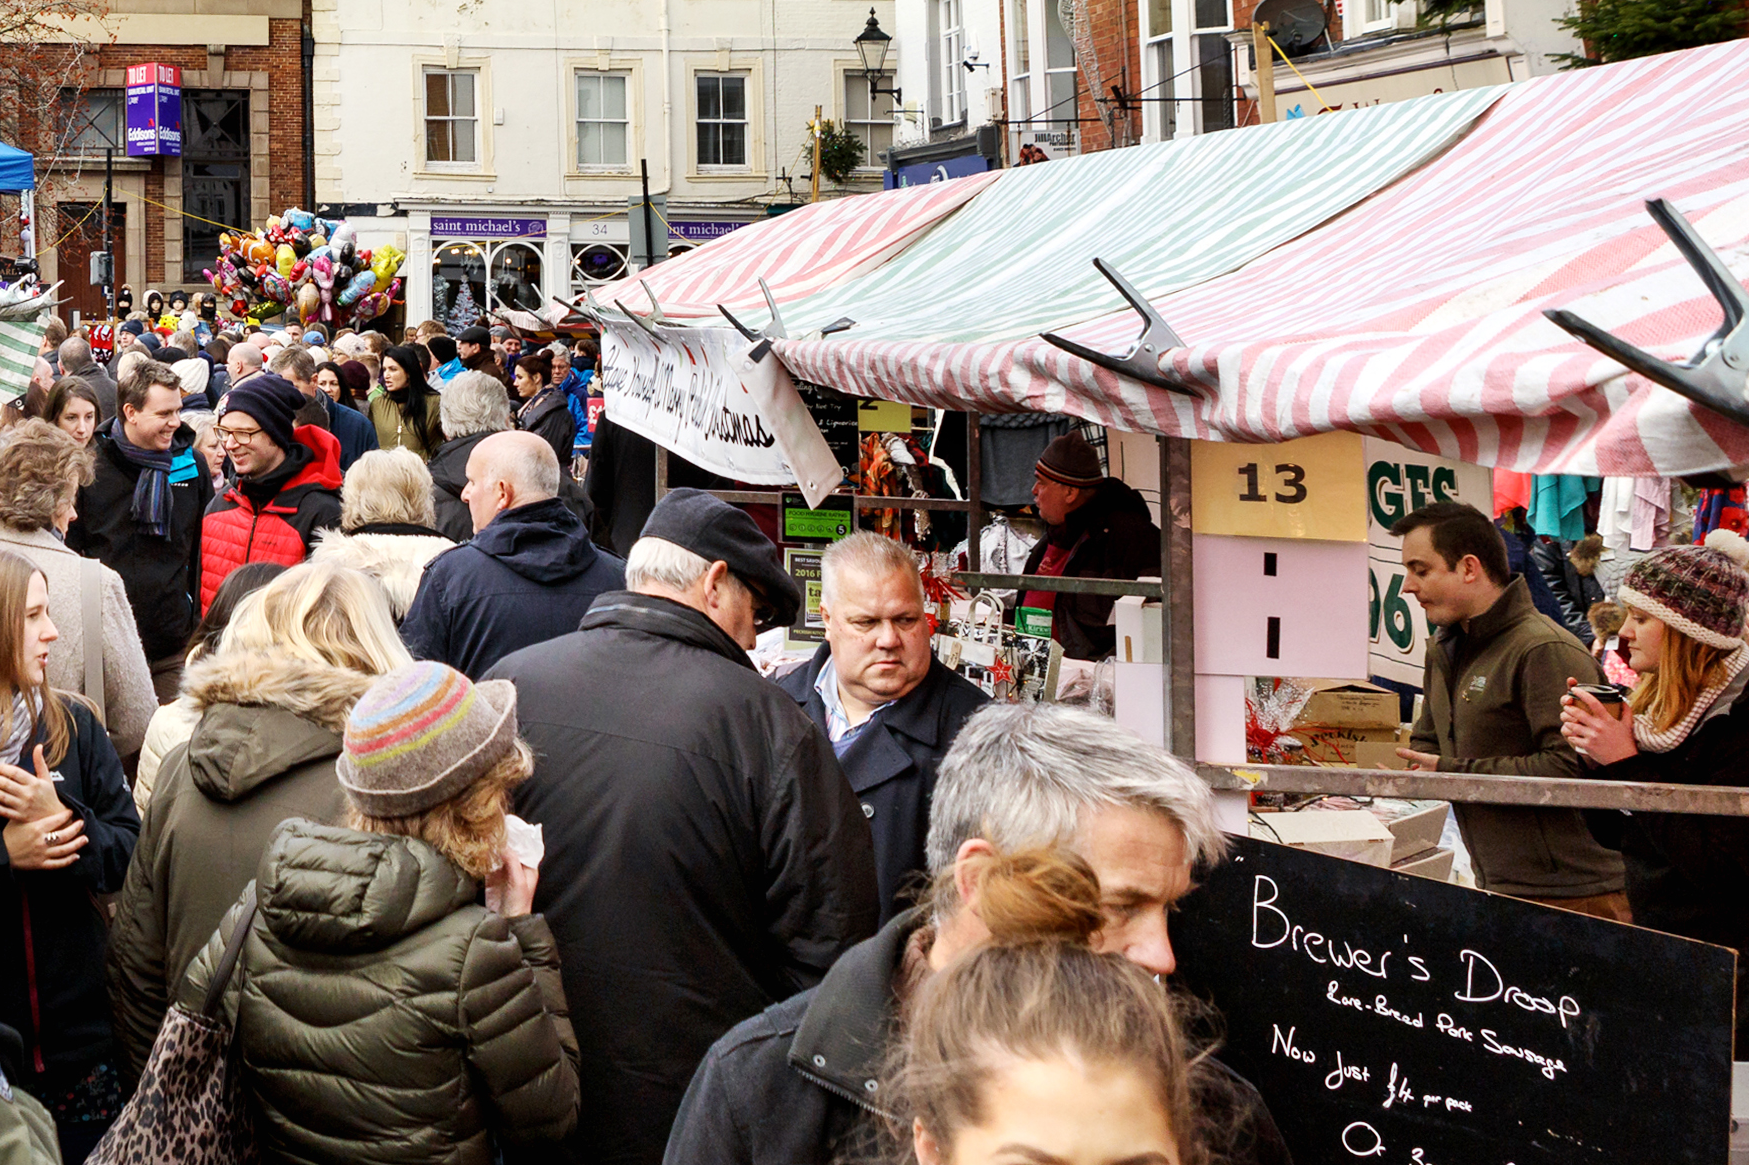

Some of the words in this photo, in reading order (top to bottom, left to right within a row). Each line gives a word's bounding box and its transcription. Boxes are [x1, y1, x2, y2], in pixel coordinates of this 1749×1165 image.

[128, 68, 136, 84] TO
[136, 66, 147, 83] LET
[159, 66, 166, 82] TO
[166, 68, 174, 83] LET
[128, 127, 155, 141] Eddisons
[159, 126, 181, 141] Eddisons
[433, 220, 461, 231] saint
[465, 219, 521, 233] michael's
[592, 224, 608, 235] 34
[668, 222, 685, 235] int
[689, 222, 740, 235] michael'
[603, 344, 628, 392] Have
[662, 362, 688, 446] Merry
[704, 374, 775, 449] Christmas
[1237, 462, 1308, 504] 13
[838, 525, 845, 535] 5
[795, 568, 815, 578] 2016
[1251, 874, 1431, 981] Brewer's
[1454, 948, 1581, 1028] Droop
[1326, 980, 1424, 1029] Rare-Breed
[1480, 1028, 1568, 1080] Sausage
[1271, 1024, 1316, 1065] Now
[1325, 1051, 1371, 1090] Just
[1382, 1062, 1415, 1109] £4
[1423, 1093, 1442, 1107] per
[1444, 1095, 1473, 1113] pack
[1342, 1121, 1387, 1157] Or
